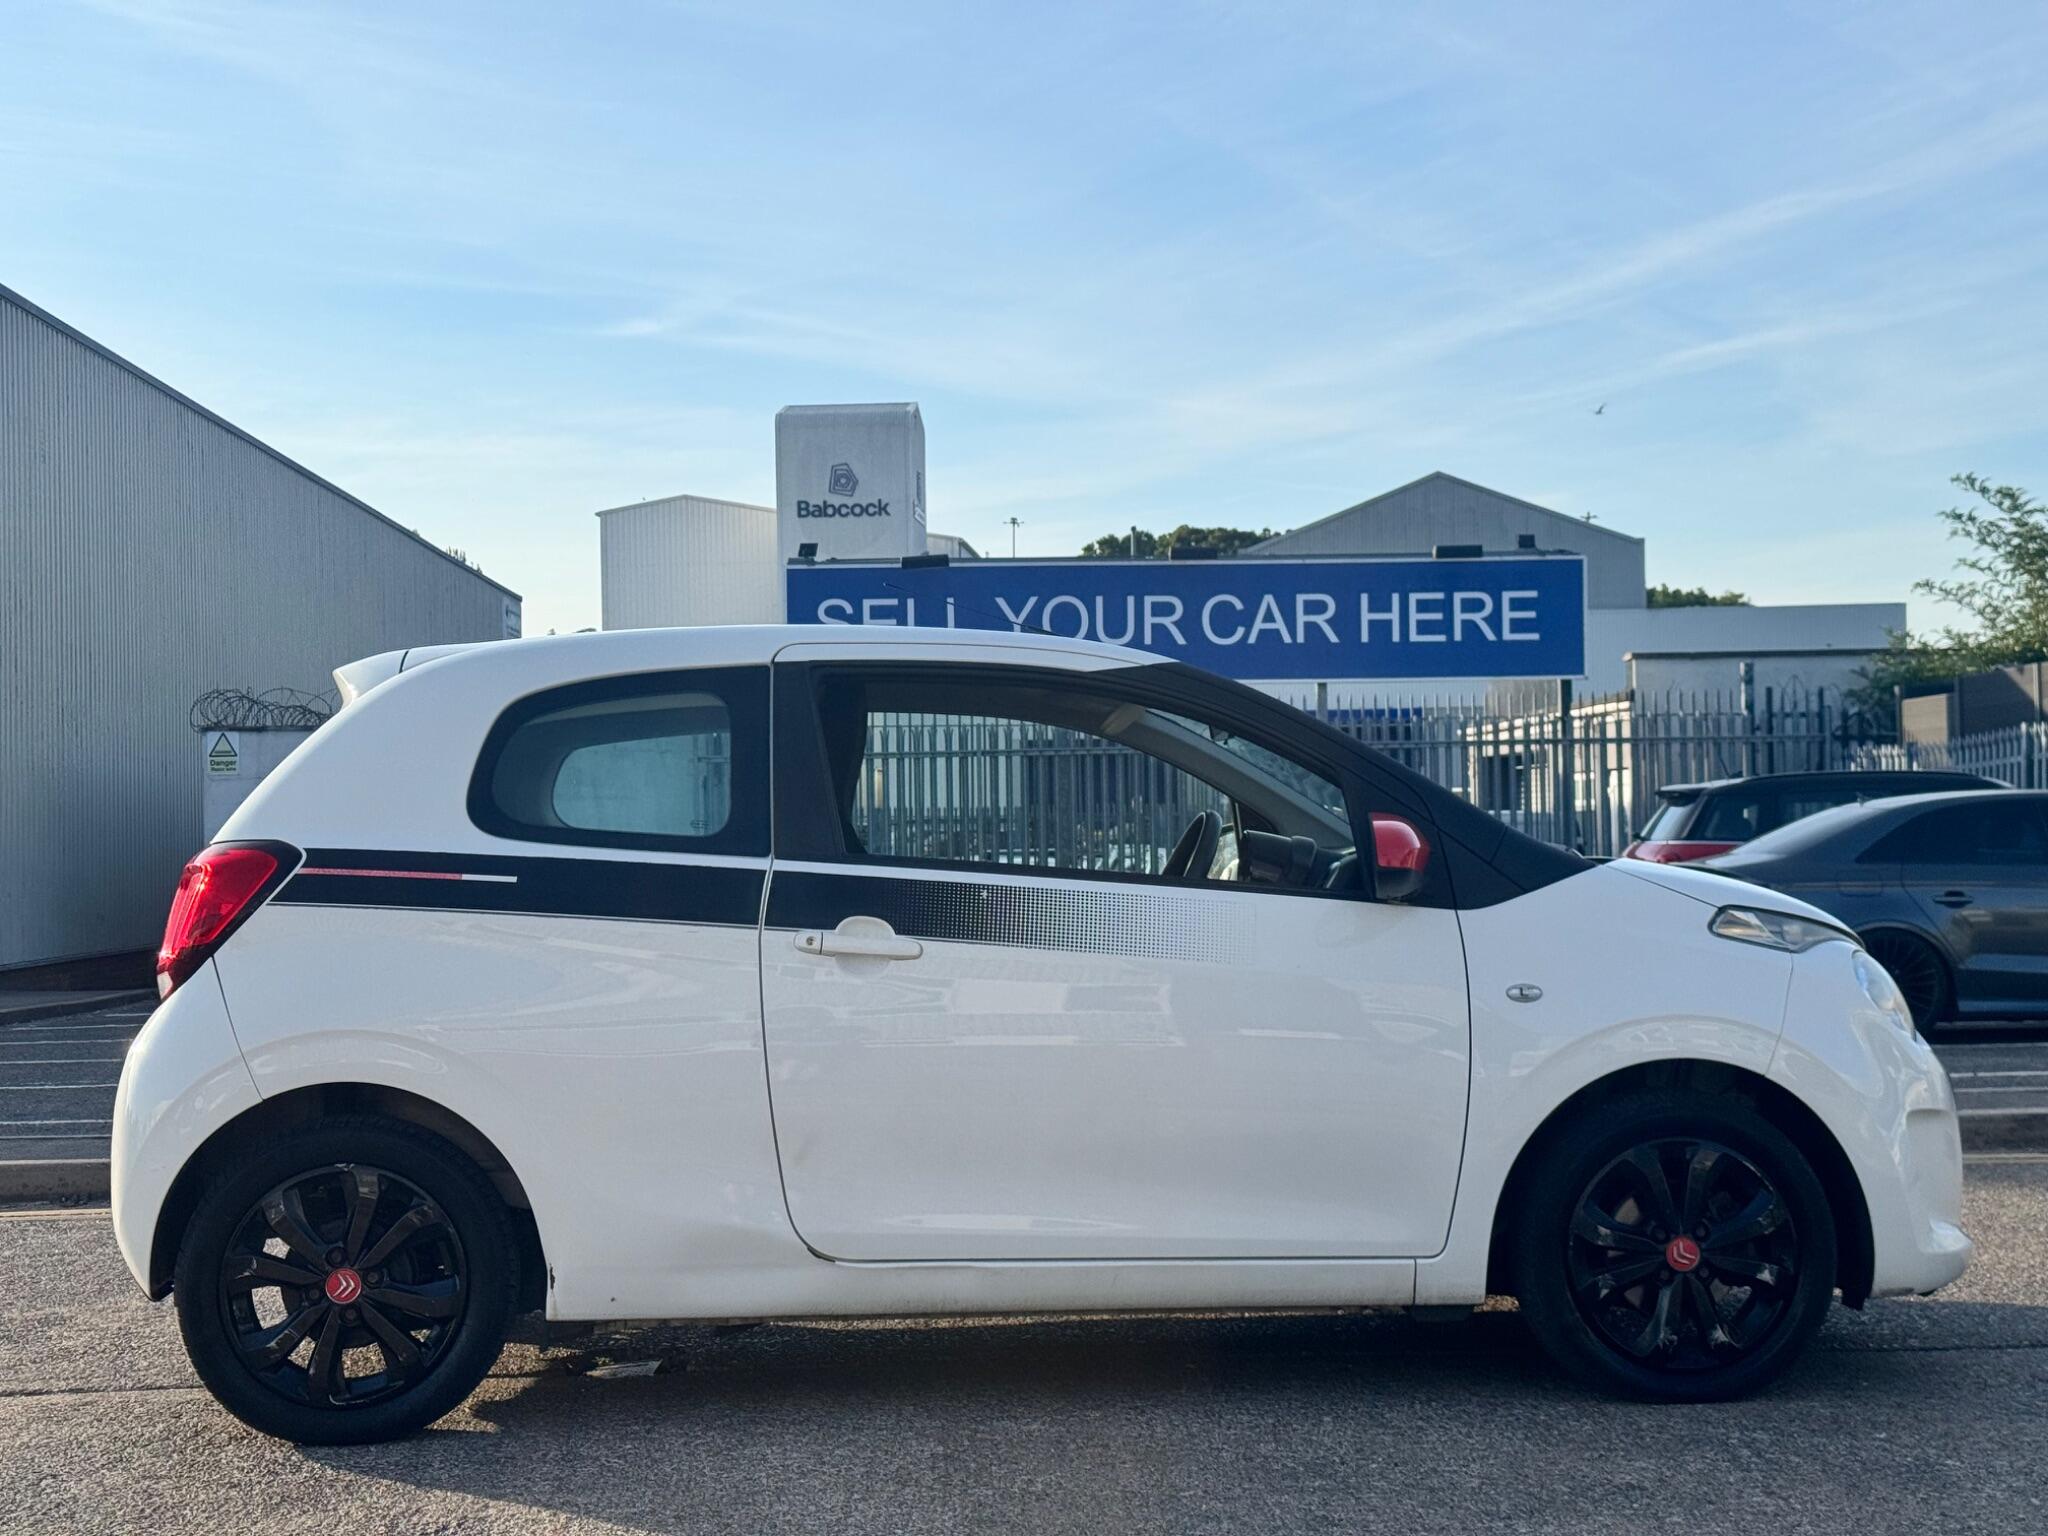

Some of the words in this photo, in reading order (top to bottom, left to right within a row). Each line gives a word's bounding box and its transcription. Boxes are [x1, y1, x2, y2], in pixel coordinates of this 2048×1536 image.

[796, 498, 891, 519] Babcock
[994, 594, 1188, 646] YOUR
[1201, 593, 1341, 646] CAR
[1360, 590, 1541, 643] HERE
